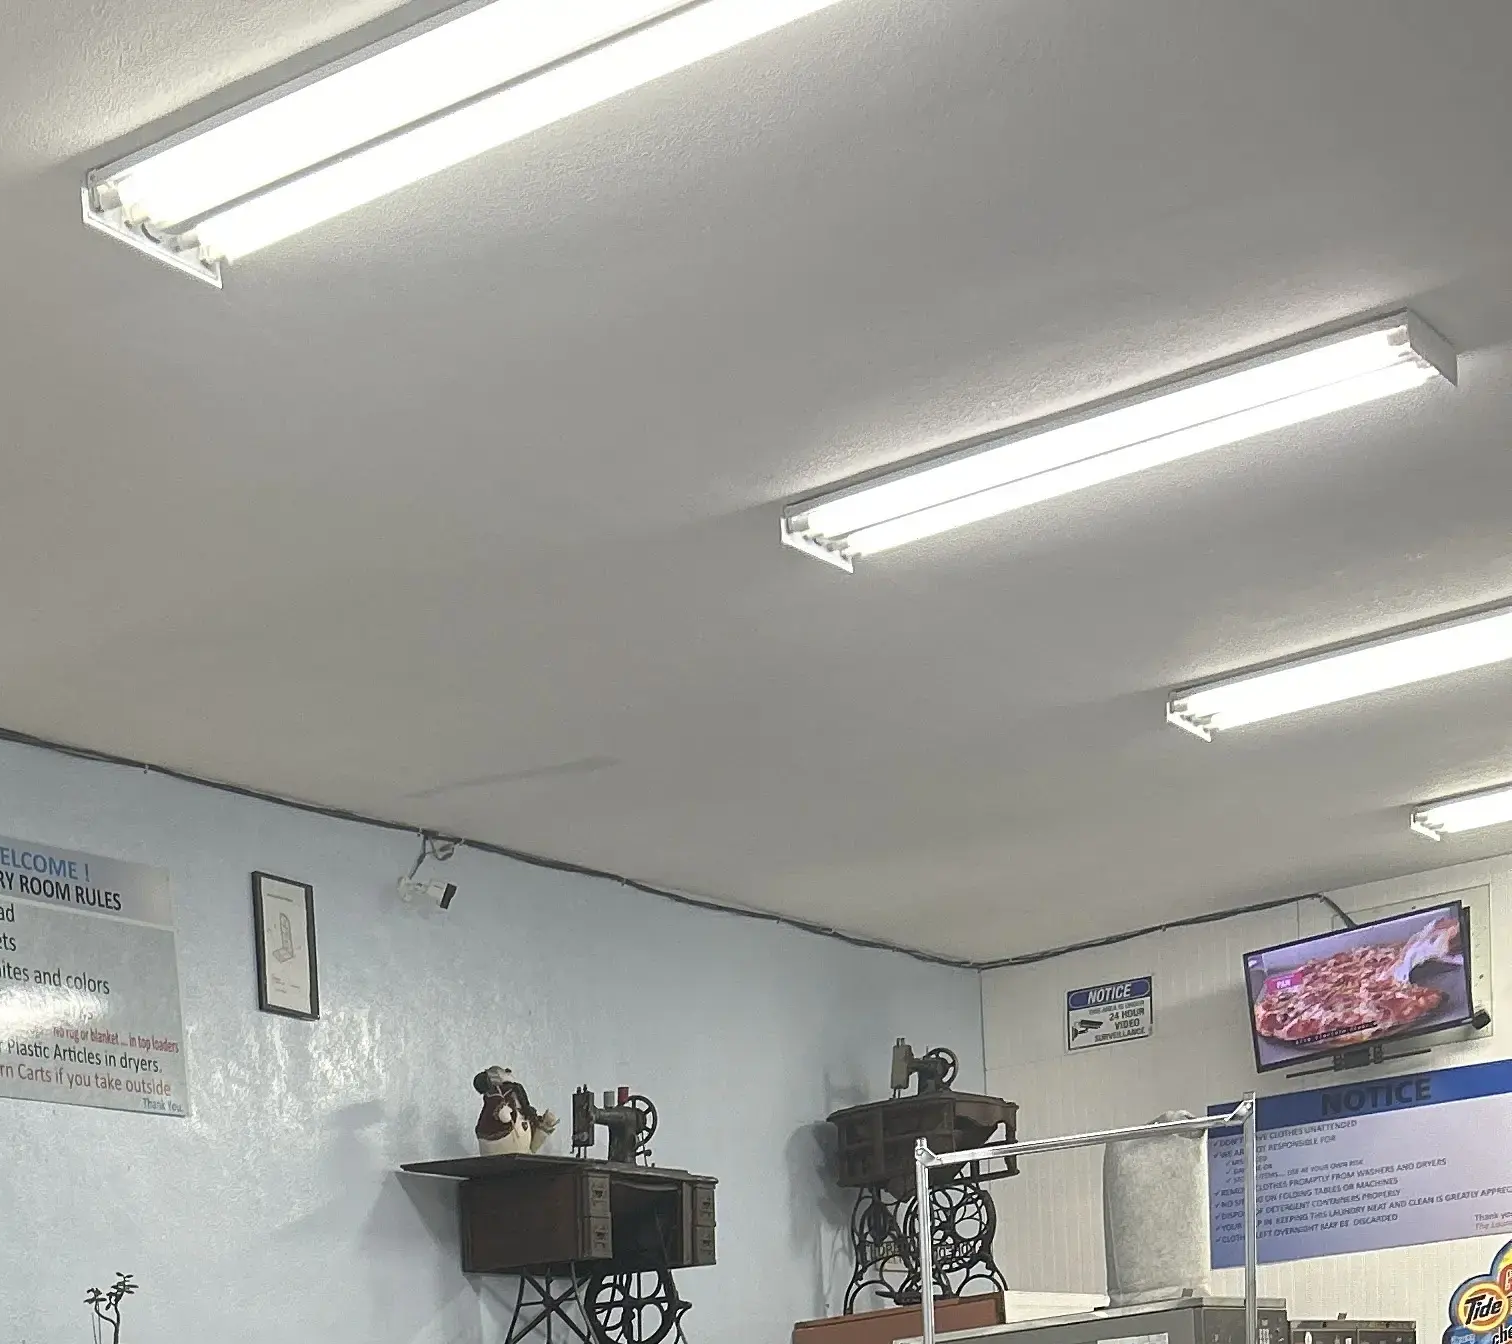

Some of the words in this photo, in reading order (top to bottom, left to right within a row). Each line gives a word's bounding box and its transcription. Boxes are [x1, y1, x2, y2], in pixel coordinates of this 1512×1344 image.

[19, 874, 71, 902] ROOM
[75, 885, 122, 911] RULES
[33, 967, 61, 988] and
[66, 971, 110, 995] colors
[1088, 983, 1132, 1004] NOTICE
[1108, 1011, 1119, 1021] 24
[1121, 1008, 1145, 1019] HOUR
[1114, 1018, 1140, 1030] VIDEO
[90, 1028, 120, 1046] blanket
[1094, 1027, 1146, 1042] SURVEILLANCE
[7, 1038, 50, 1059] Plastic
[53, 1043, 102, 1066] Articles
[105, 1050, 116, 1068] in
[120, 1052, 163, 1074] dryers.
[18, 1063, 52, 1083] Carts
[55, 1066, 64, 1085] if
[68, 1072, 91, 1090] you
[94, 1073, 122, 1091] take
[126, 1078, 172, 1097] outside
[142, 1098, 165, 1110] Thank
[1321, 1078, 1432, 1116] NOTICE
[1357, 1165, 1394, 1177] WASHERS
[1396, 1163, 1414, 1171] AND
[1416, 1158, 1447, 1169] DRYERS
[1388, 1200, 1407, 1209] AND
[1408, 1197, 1435, 1207] CLEAN
[1444, 1190, 1480, 1202] GREATLY
[1464, 1294, 1503, 1326] Tide
